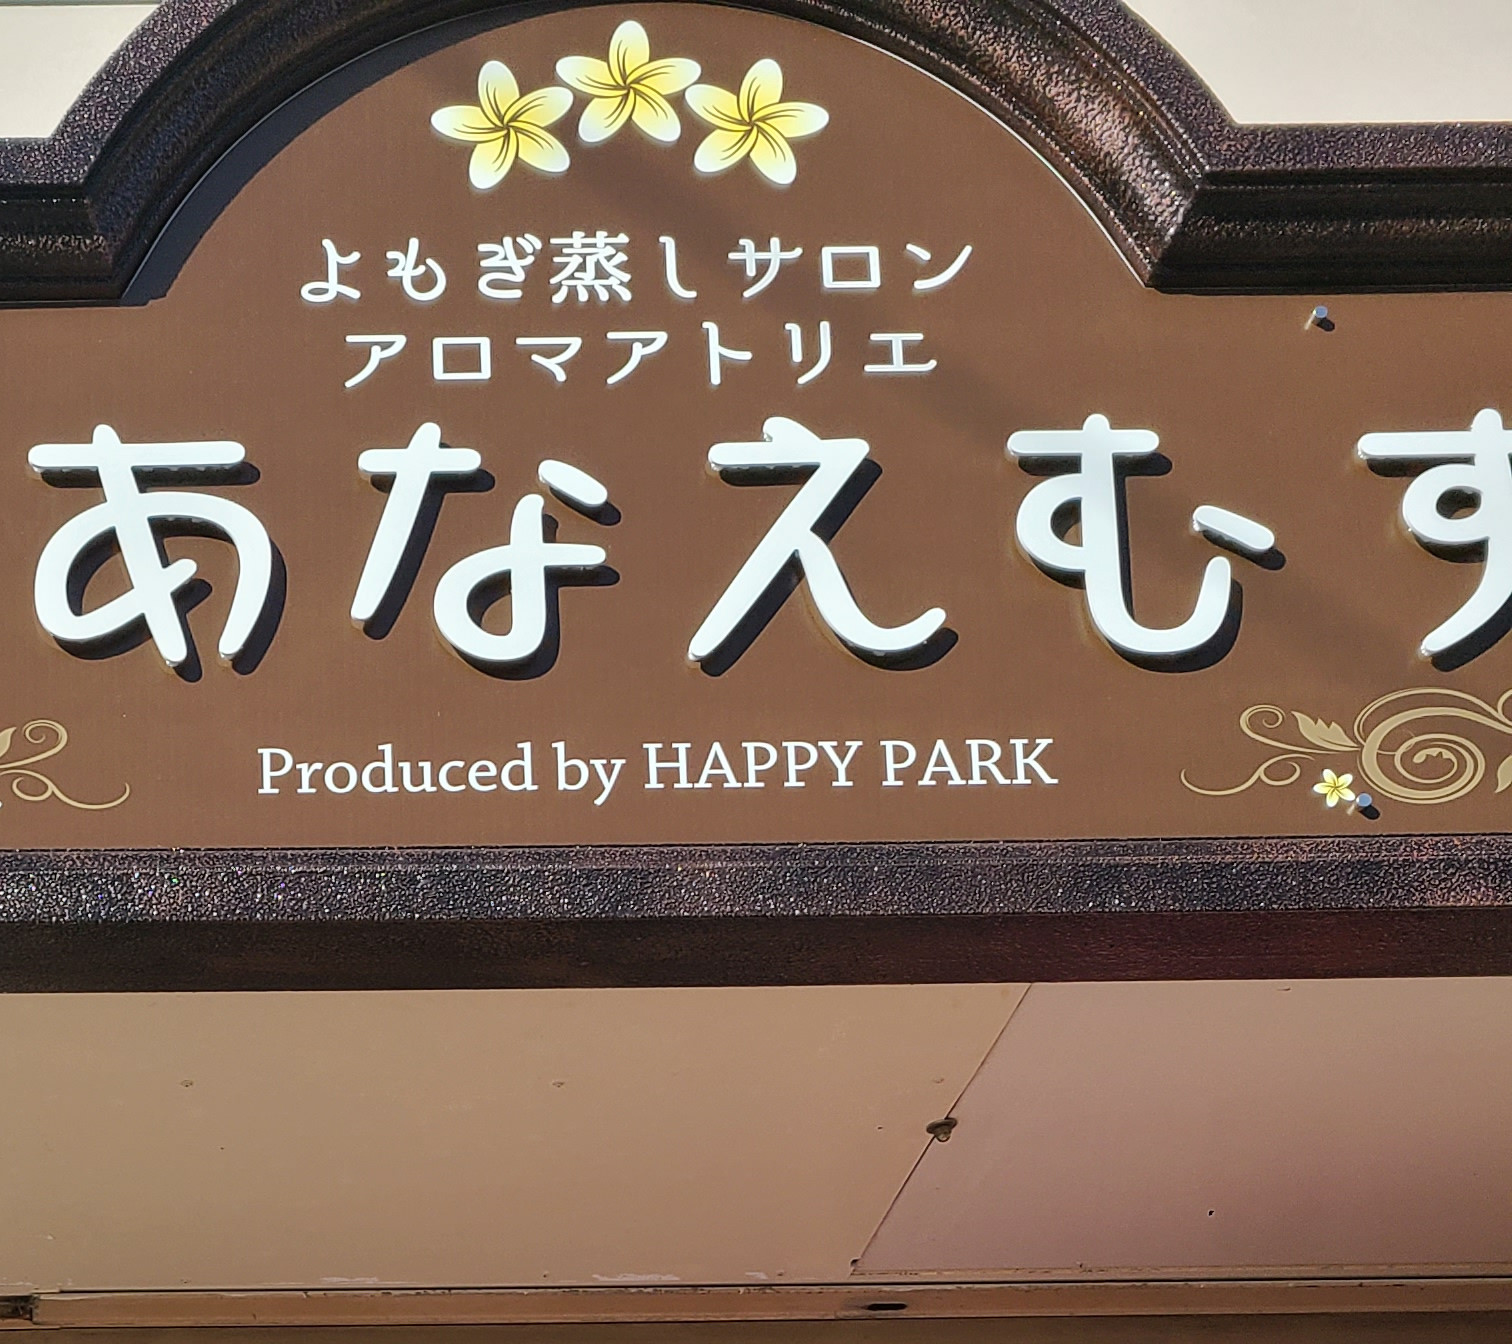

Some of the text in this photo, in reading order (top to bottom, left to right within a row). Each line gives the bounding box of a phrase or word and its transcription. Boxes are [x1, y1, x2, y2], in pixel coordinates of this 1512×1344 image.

[299, 231, 975, 306] よもぎ蒸しサロン
[343, 320, 938, 390] アロマアトリエ
[256, 737, 1059, 806] Produced by HAPPY PARK
